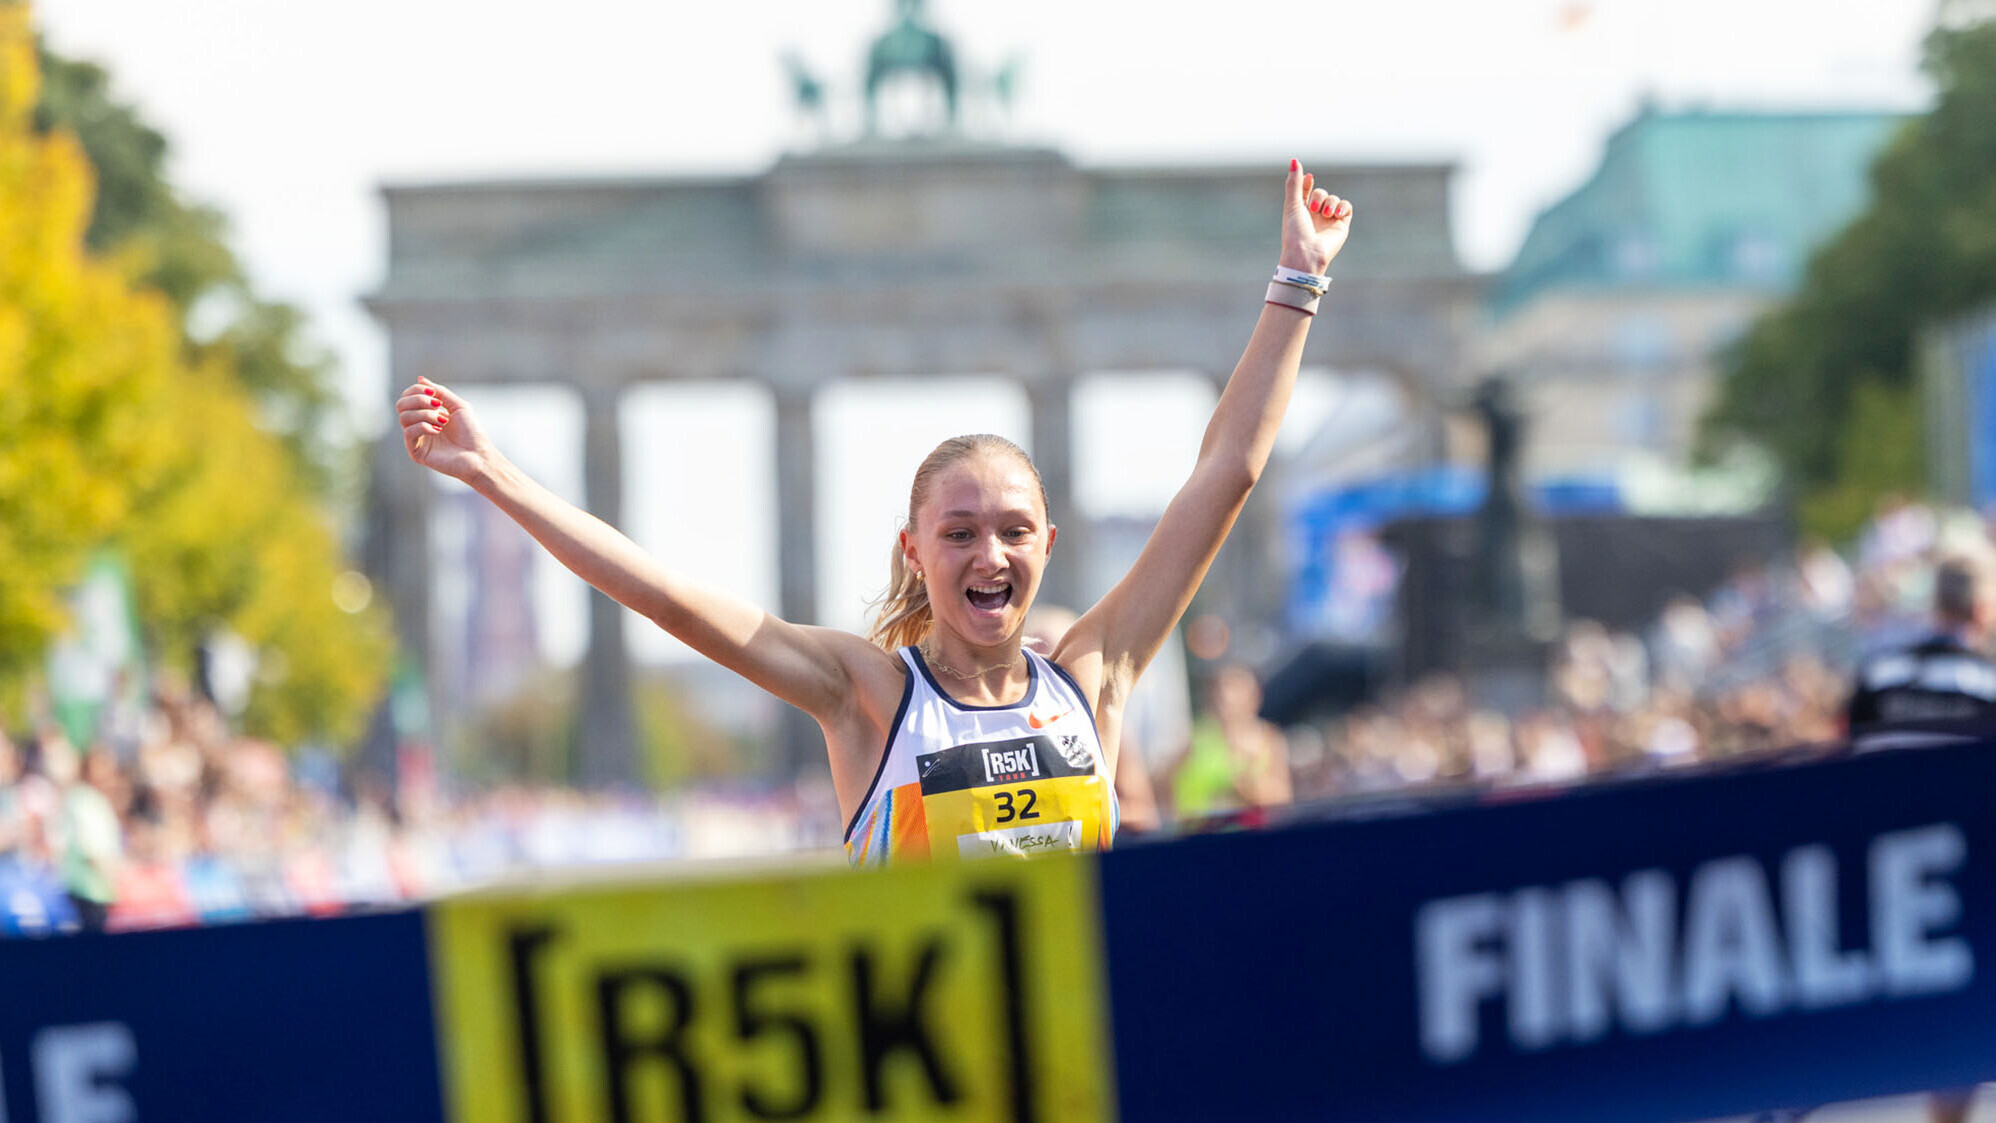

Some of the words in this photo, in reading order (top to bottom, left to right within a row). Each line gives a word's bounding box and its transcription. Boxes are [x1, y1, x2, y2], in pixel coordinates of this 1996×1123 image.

[981, 742, 1040, 783] [R5K]
[994, 788, 1040, 824] 32
[1416, 824, 1975, 1062] FINALE
